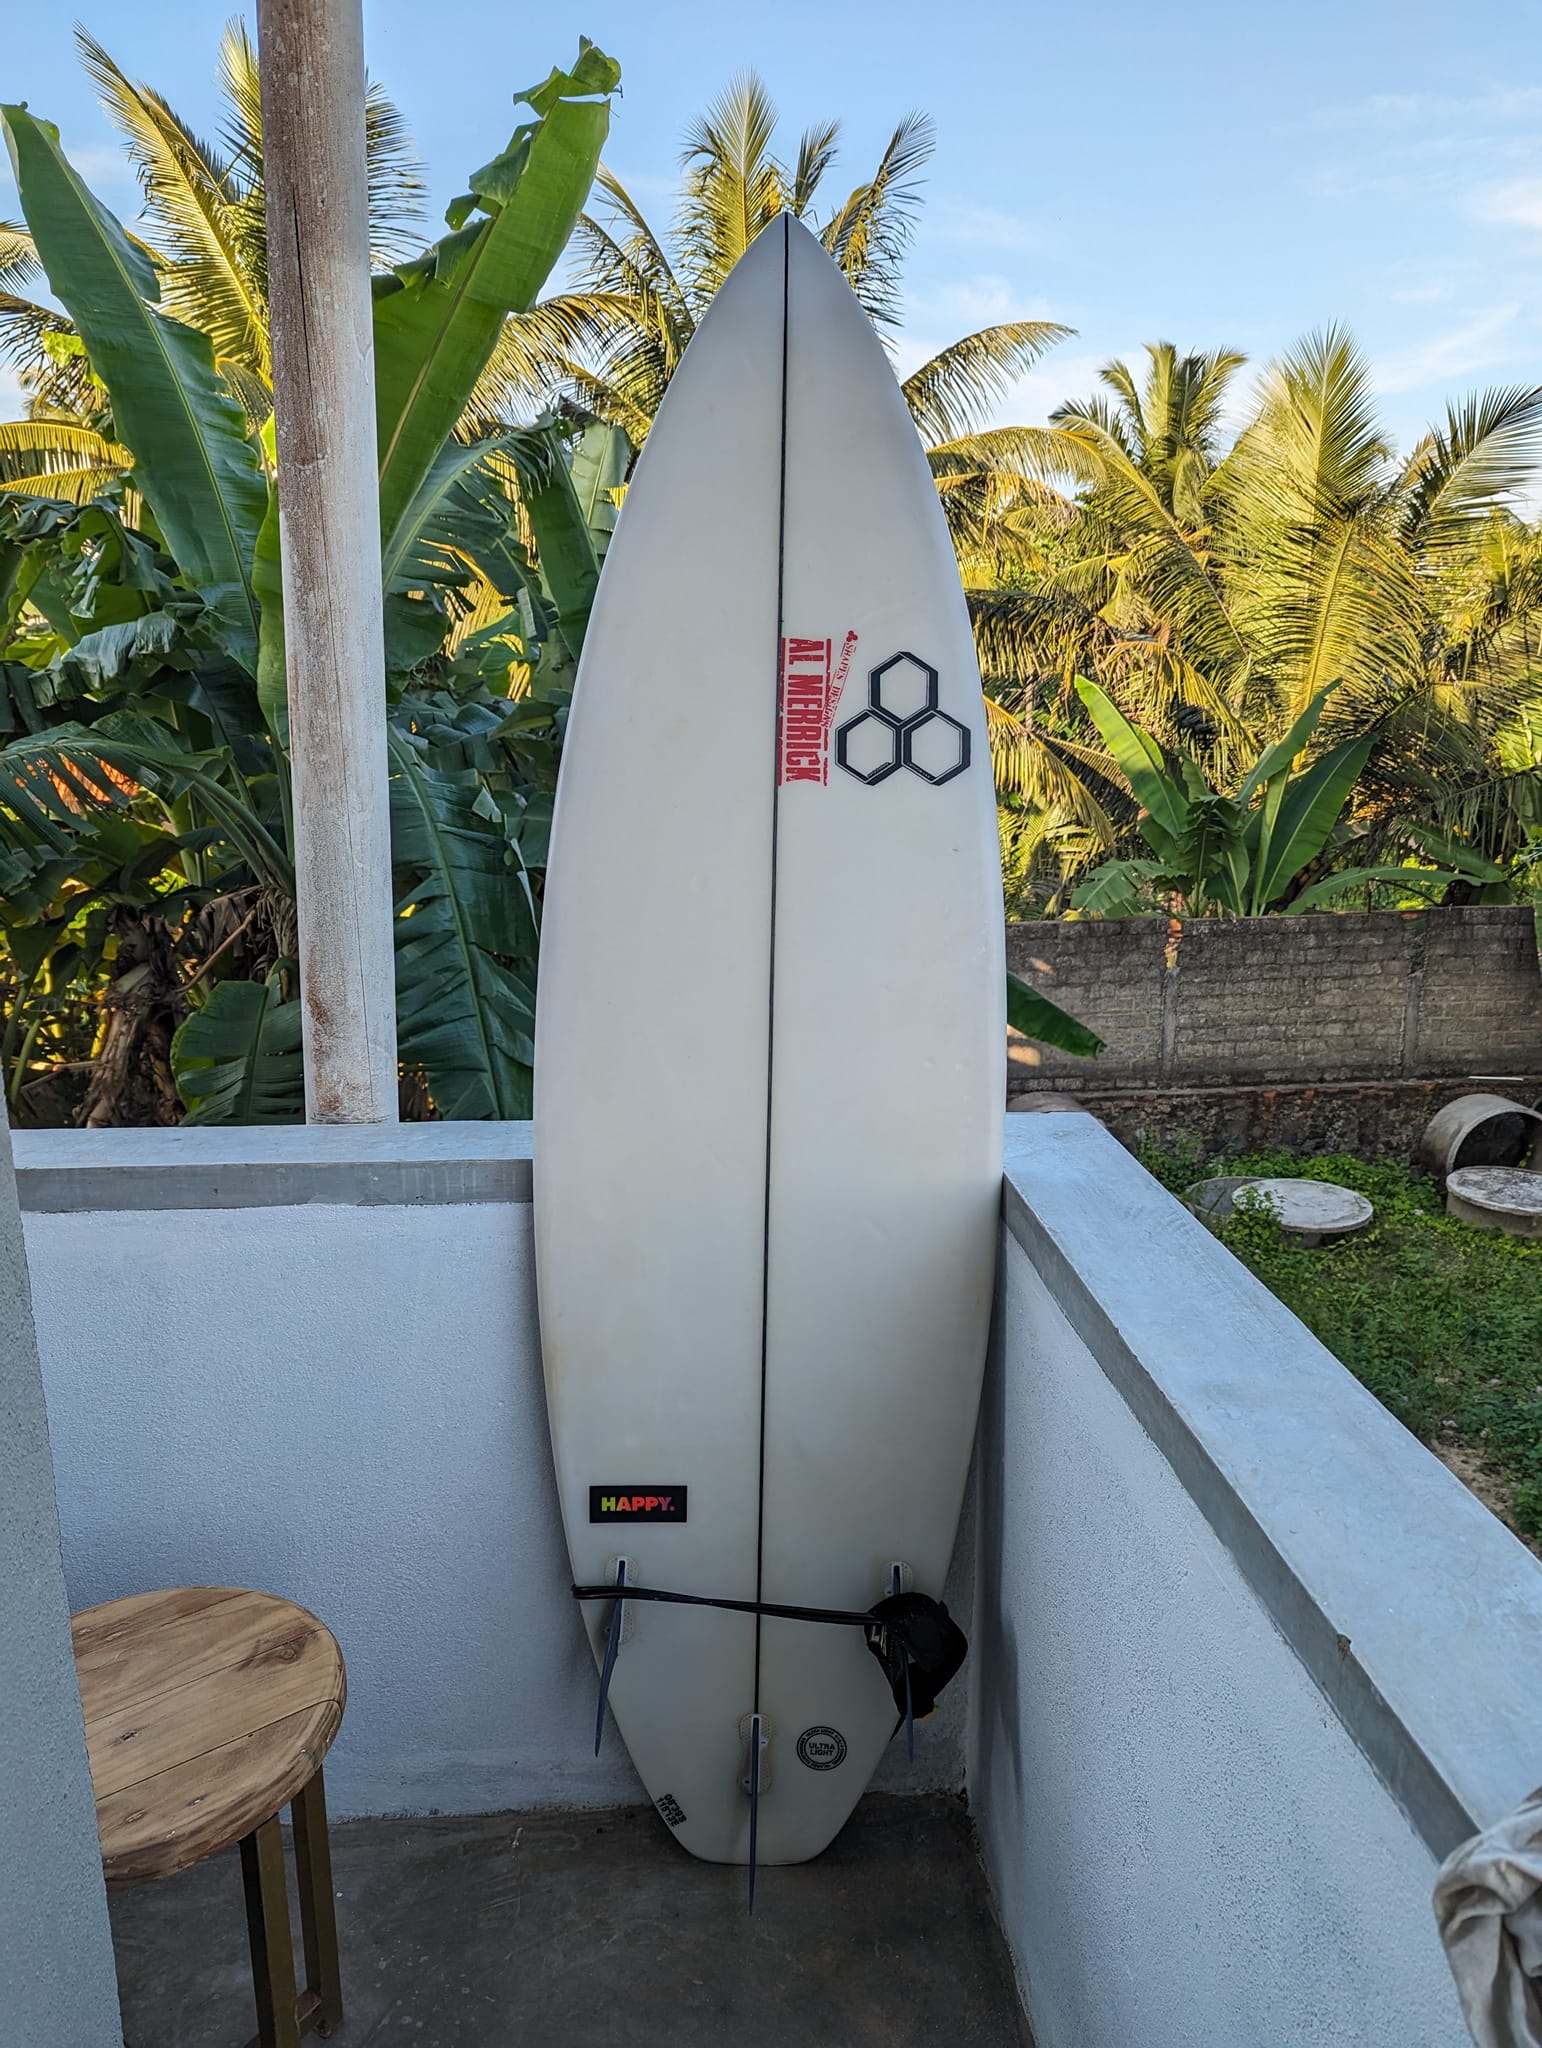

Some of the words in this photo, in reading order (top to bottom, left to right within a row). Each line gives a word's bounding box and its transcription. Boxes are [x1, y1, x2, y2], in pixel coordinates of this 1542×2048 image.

[788, 638, 825, 665] AL
[836, 641, 855, 681] SHAPES
[821, 684, 841, 728] DESIGNS
[787, 674, 825, 782] MERRICK
[601, 1496, 676, 1512] HAPPY.
[808, 1742, 835, 1750] ULTRA
[810, 1749, 834, 1757] LIGHT
